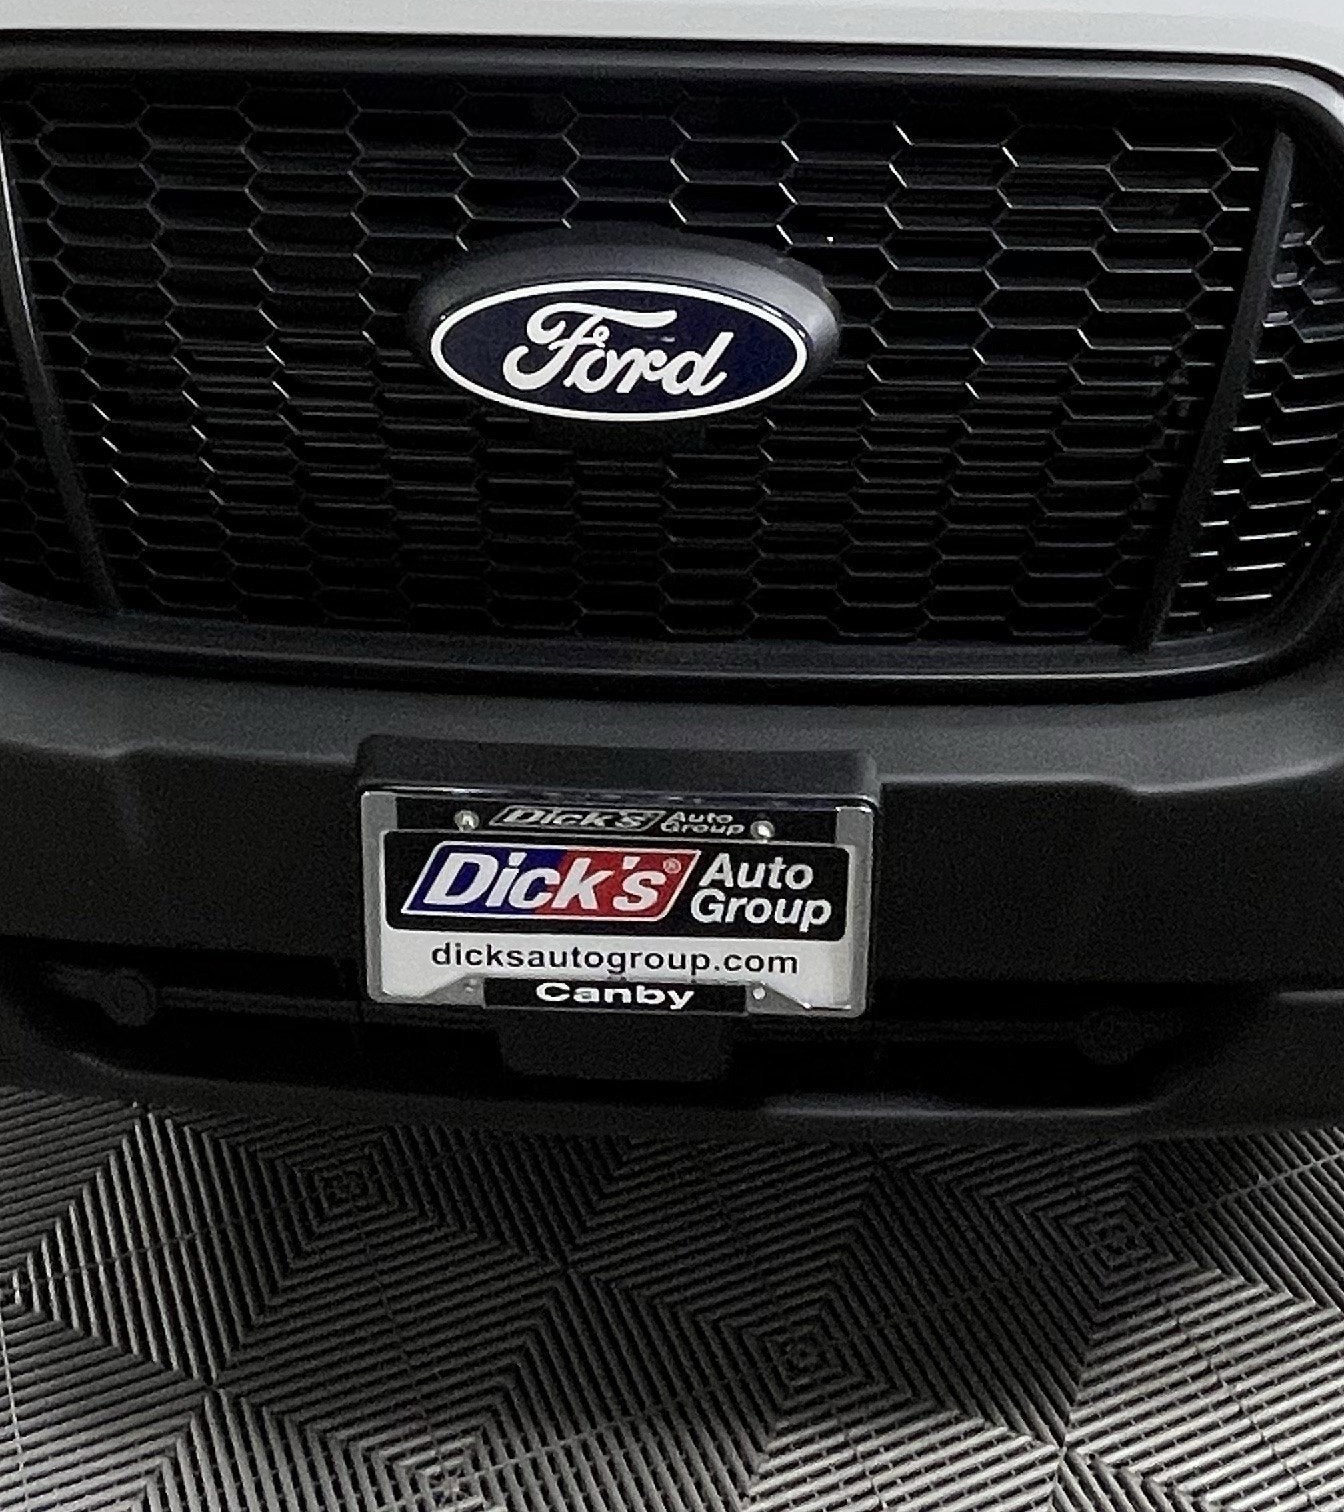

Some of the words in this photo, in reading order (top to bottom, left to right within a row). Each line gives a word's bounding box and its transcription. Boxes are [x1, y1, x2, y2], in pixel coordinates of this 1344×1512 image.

[502, 301, 736, 397] Ford
[660, 821, 745, 836] Group
[666, 811, 734, 824] Auto
[423, 852, 667, 912] Dick's
[698, 852, 814, 890] Auto
[690, 888, 832, 933] Group
[430, 942, 799, 974] dicksautogroup.com
[535, 981, 695, 1010] Canby
